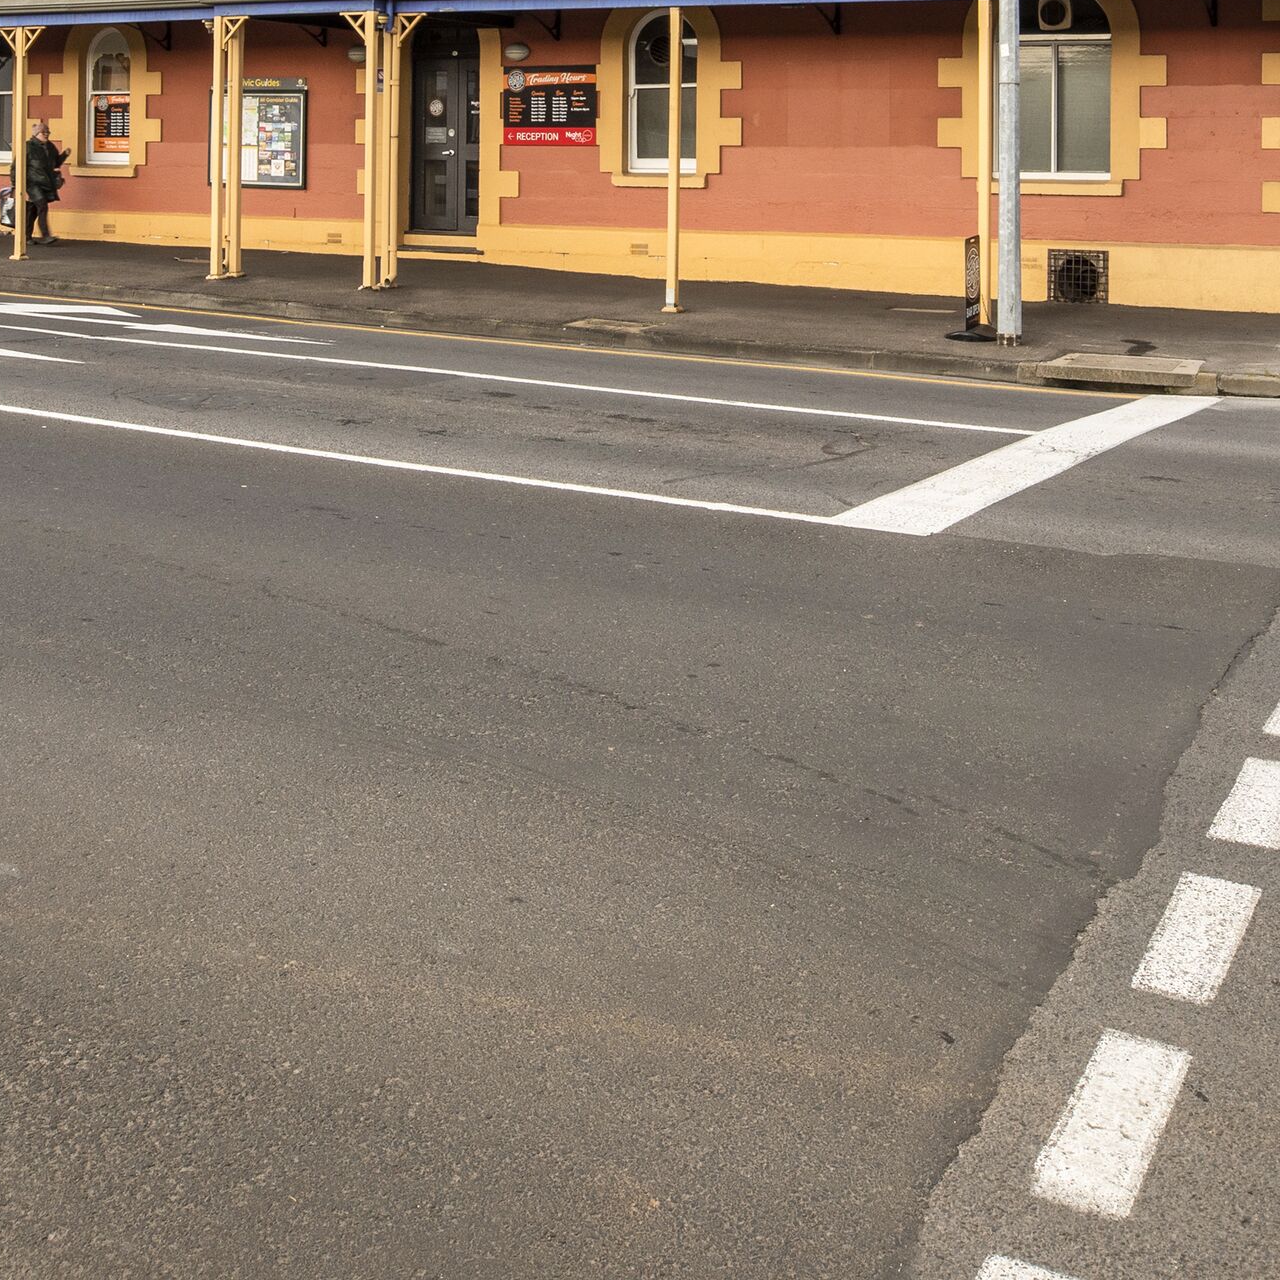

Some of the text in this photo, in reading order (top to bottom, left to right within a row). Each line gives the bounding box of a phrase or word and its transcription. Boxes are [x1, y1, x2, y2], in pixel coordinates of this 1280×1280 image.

[255, 78, 280, 87] Guides
[527, 73, 559, 86] Trading
[560, 72, 587, 84] Hours
[516, 132, 559, 141] RECEPTION
[565, 131, 582, 140] Night
